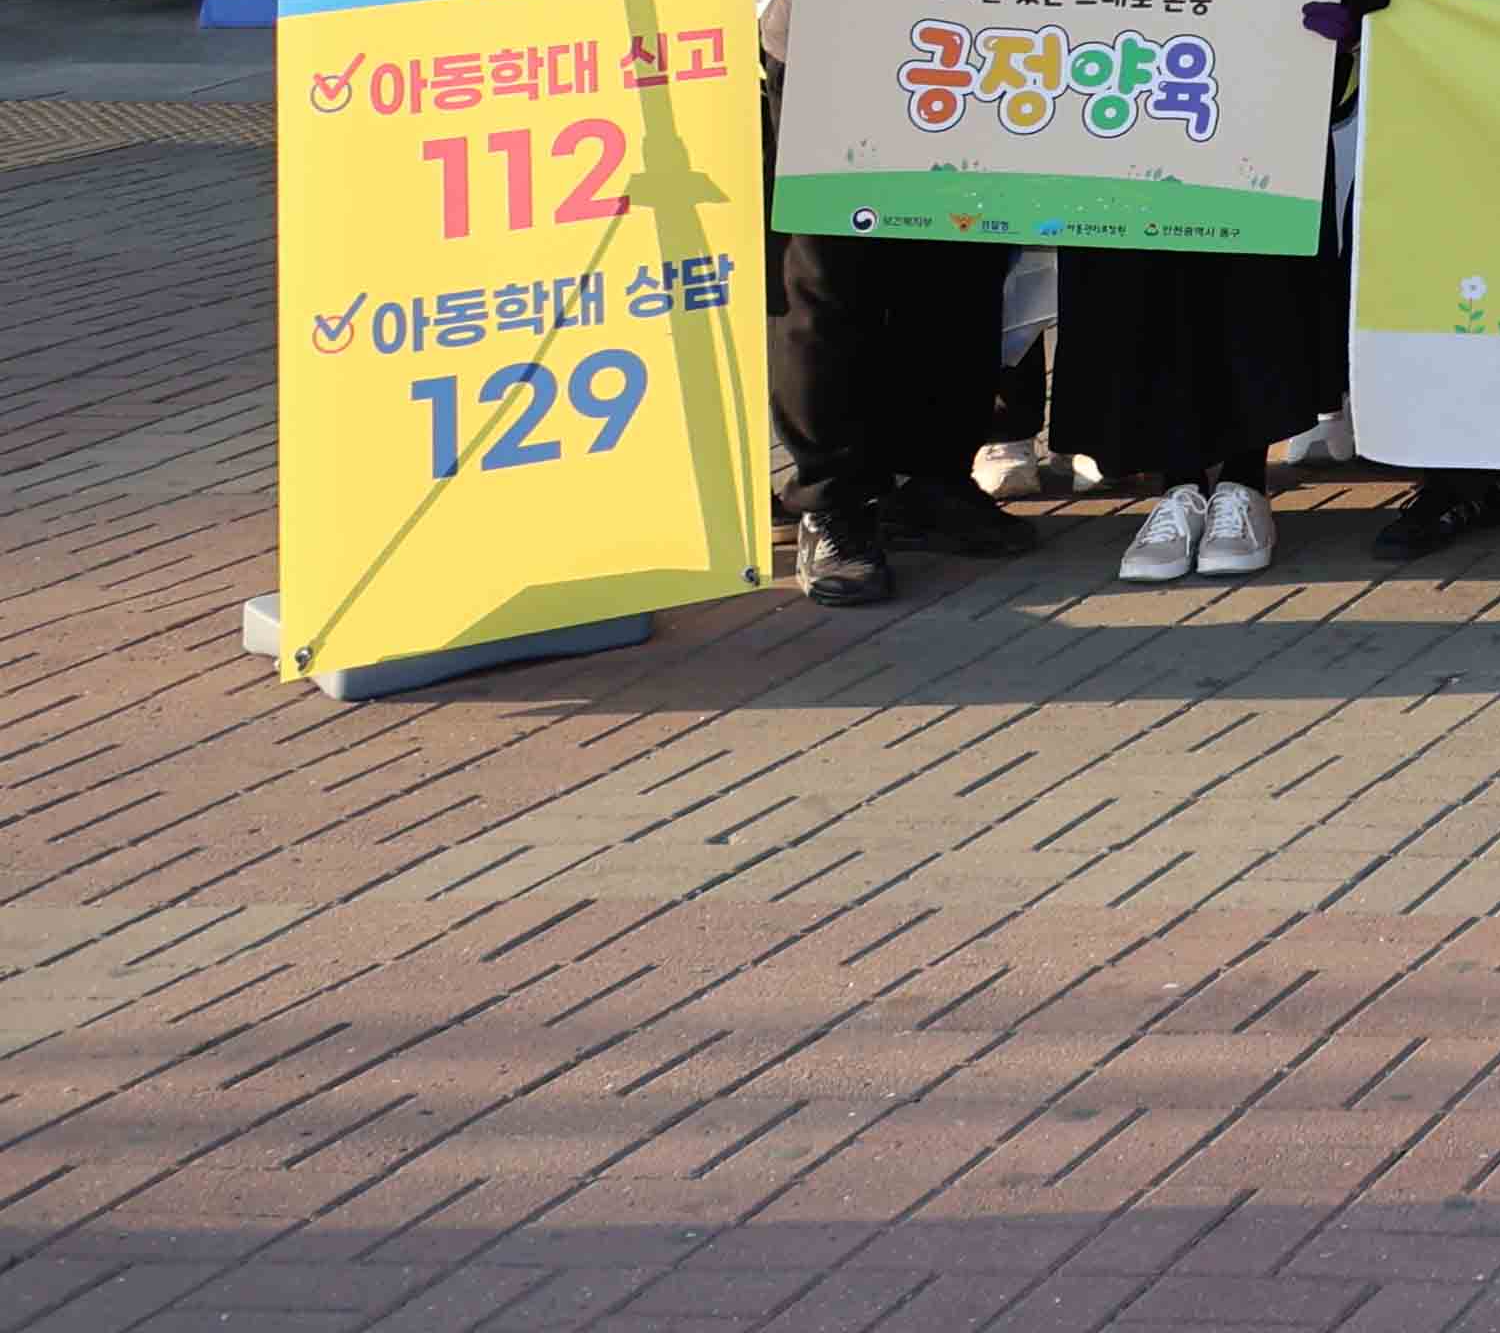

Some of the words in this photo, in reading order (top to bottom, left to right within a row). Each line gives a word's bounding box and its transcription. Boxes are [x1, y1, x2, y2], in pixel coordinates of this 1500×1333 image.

[370, 39, 598, 117] 아동학대
[619, 27, 728, 89] 신고
[899, 19, 1218, 142] 긍정양육
[422, 117, 630, 240] 112
[372, 271, 606, 355] 아동학대
[624, 254, 735, 321] 상담
[411, 347, 648, 480] 129
